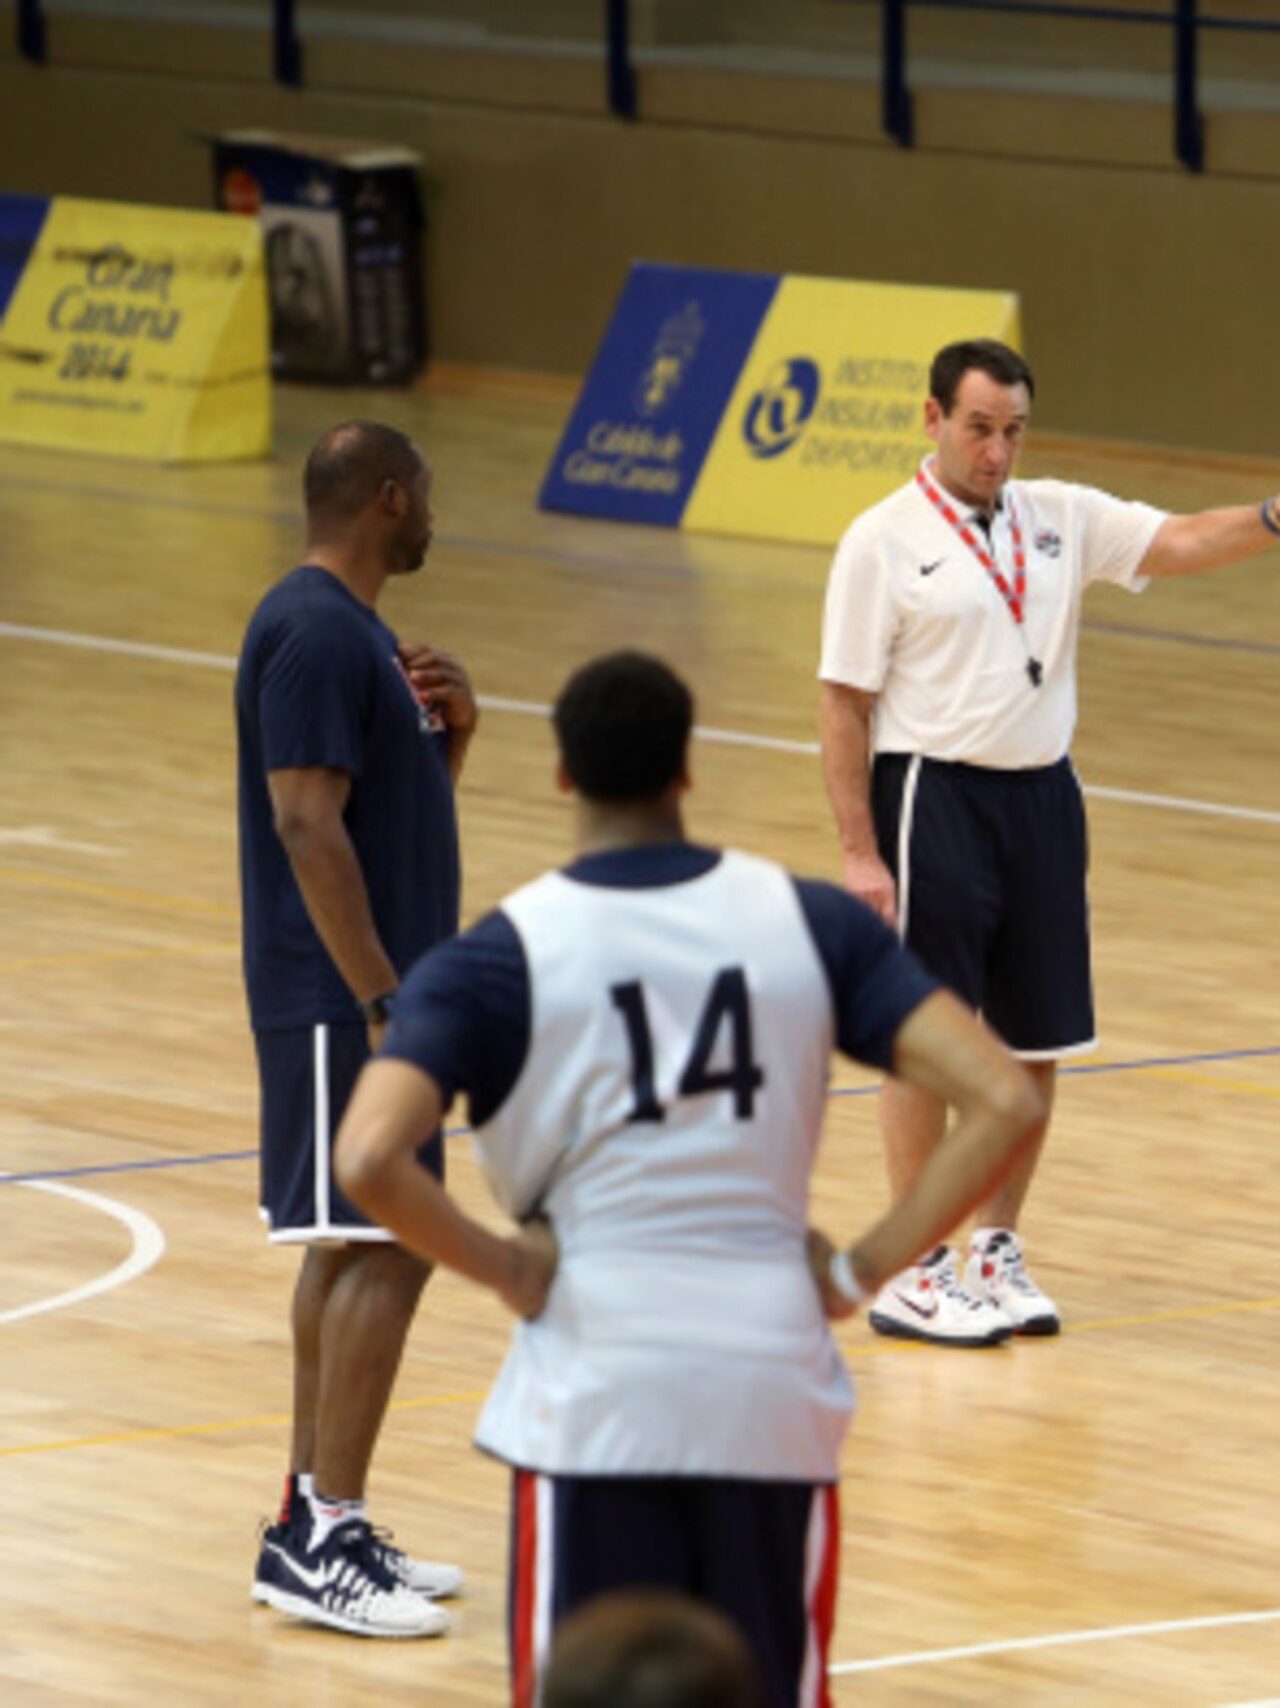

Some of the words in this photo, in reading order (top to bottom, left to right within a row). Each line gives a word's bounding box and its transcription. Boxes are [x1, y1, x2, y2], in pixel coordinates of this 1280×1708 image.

[86, 243, 176, 303] Gran
[47, 285, 182, 343] Canaria
[57, 342, 133, 382] 2014
[834, 356, 930, 392] INSTITU
[609, 965, 764, 1124] 14
